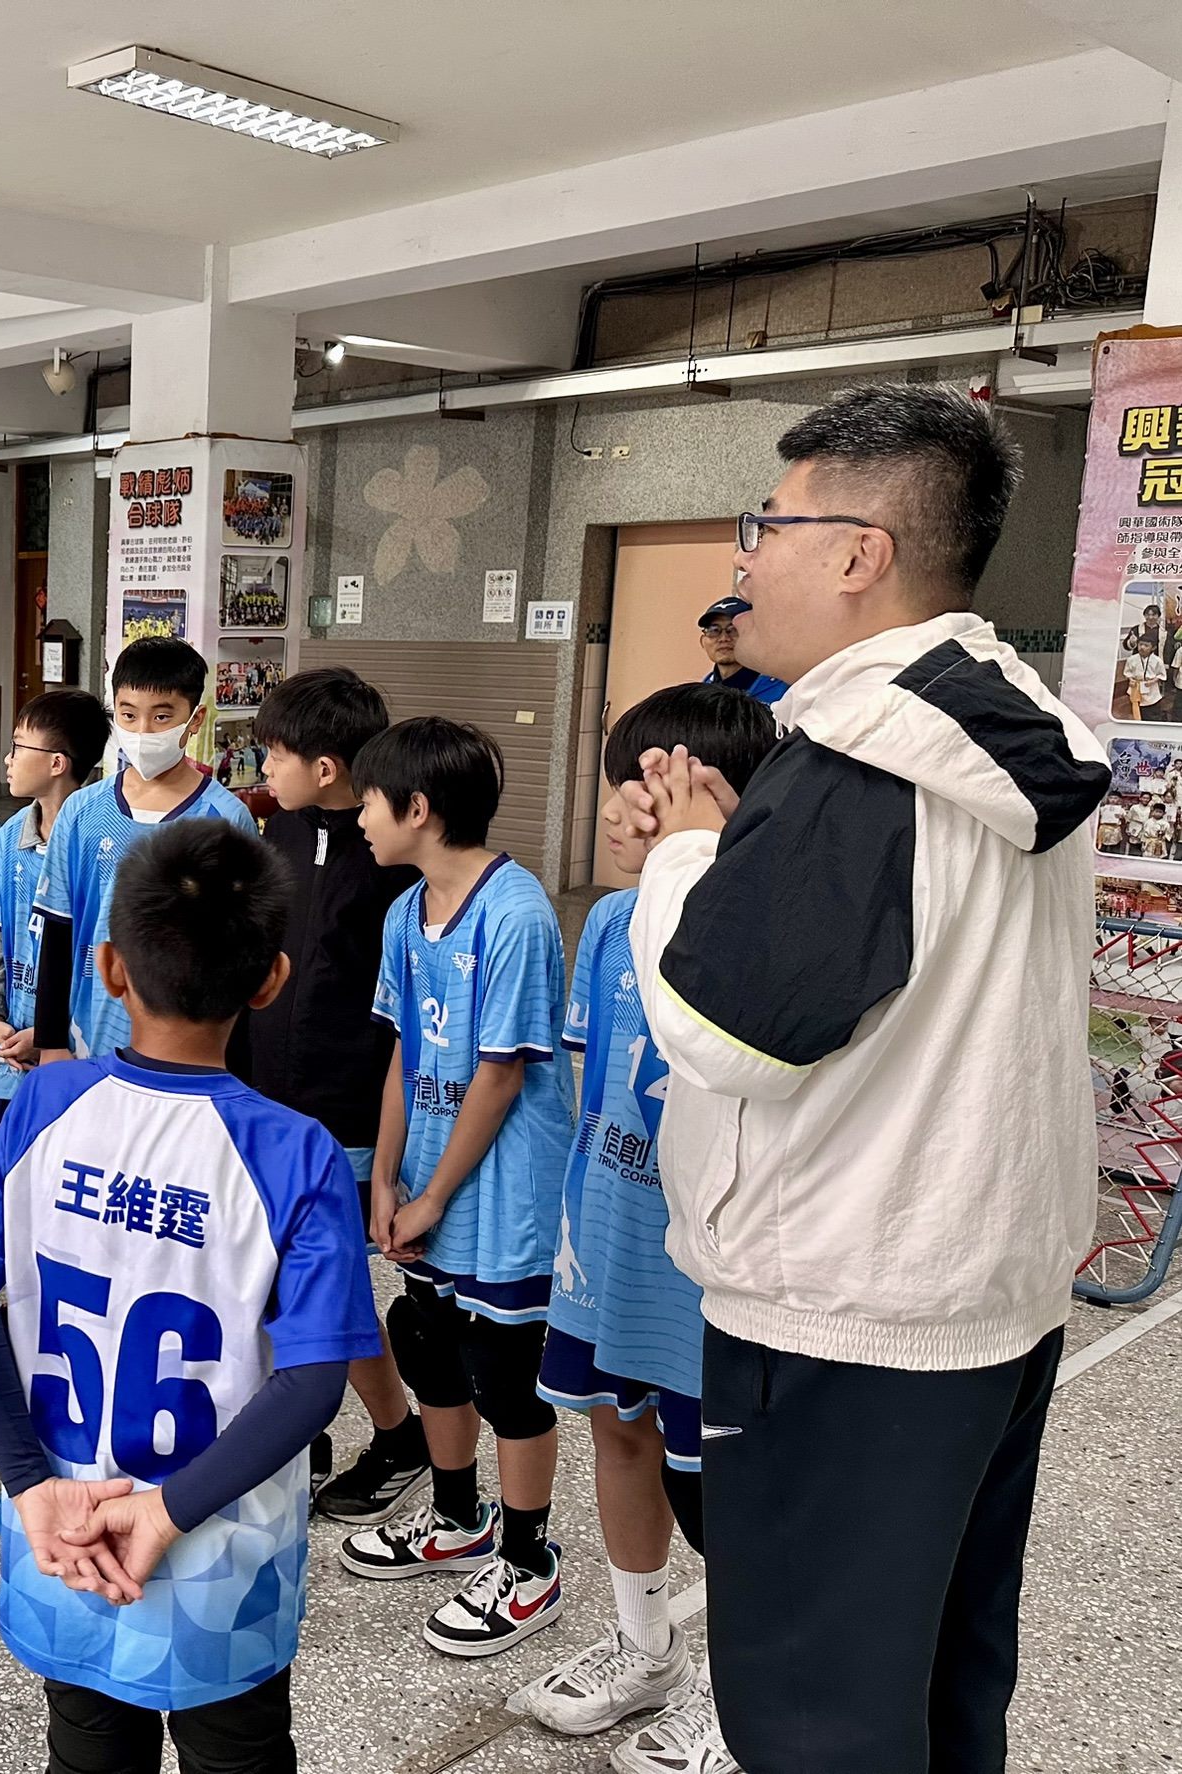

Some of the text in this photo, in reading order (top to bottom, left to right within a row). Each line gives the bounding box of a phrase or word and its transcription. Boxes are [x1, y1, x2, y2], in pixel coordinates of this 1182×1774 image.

[1118, 405, 1182, 456] 興
[119, 467, 193, 500] 戰績彪炳
[127, 499, 183, 528] 合球隊
[602, 1122, 660, 1173] 信創
[54, 1159, 211, 1249] 王維霆
[30, 1251, 223, 1485] 56
